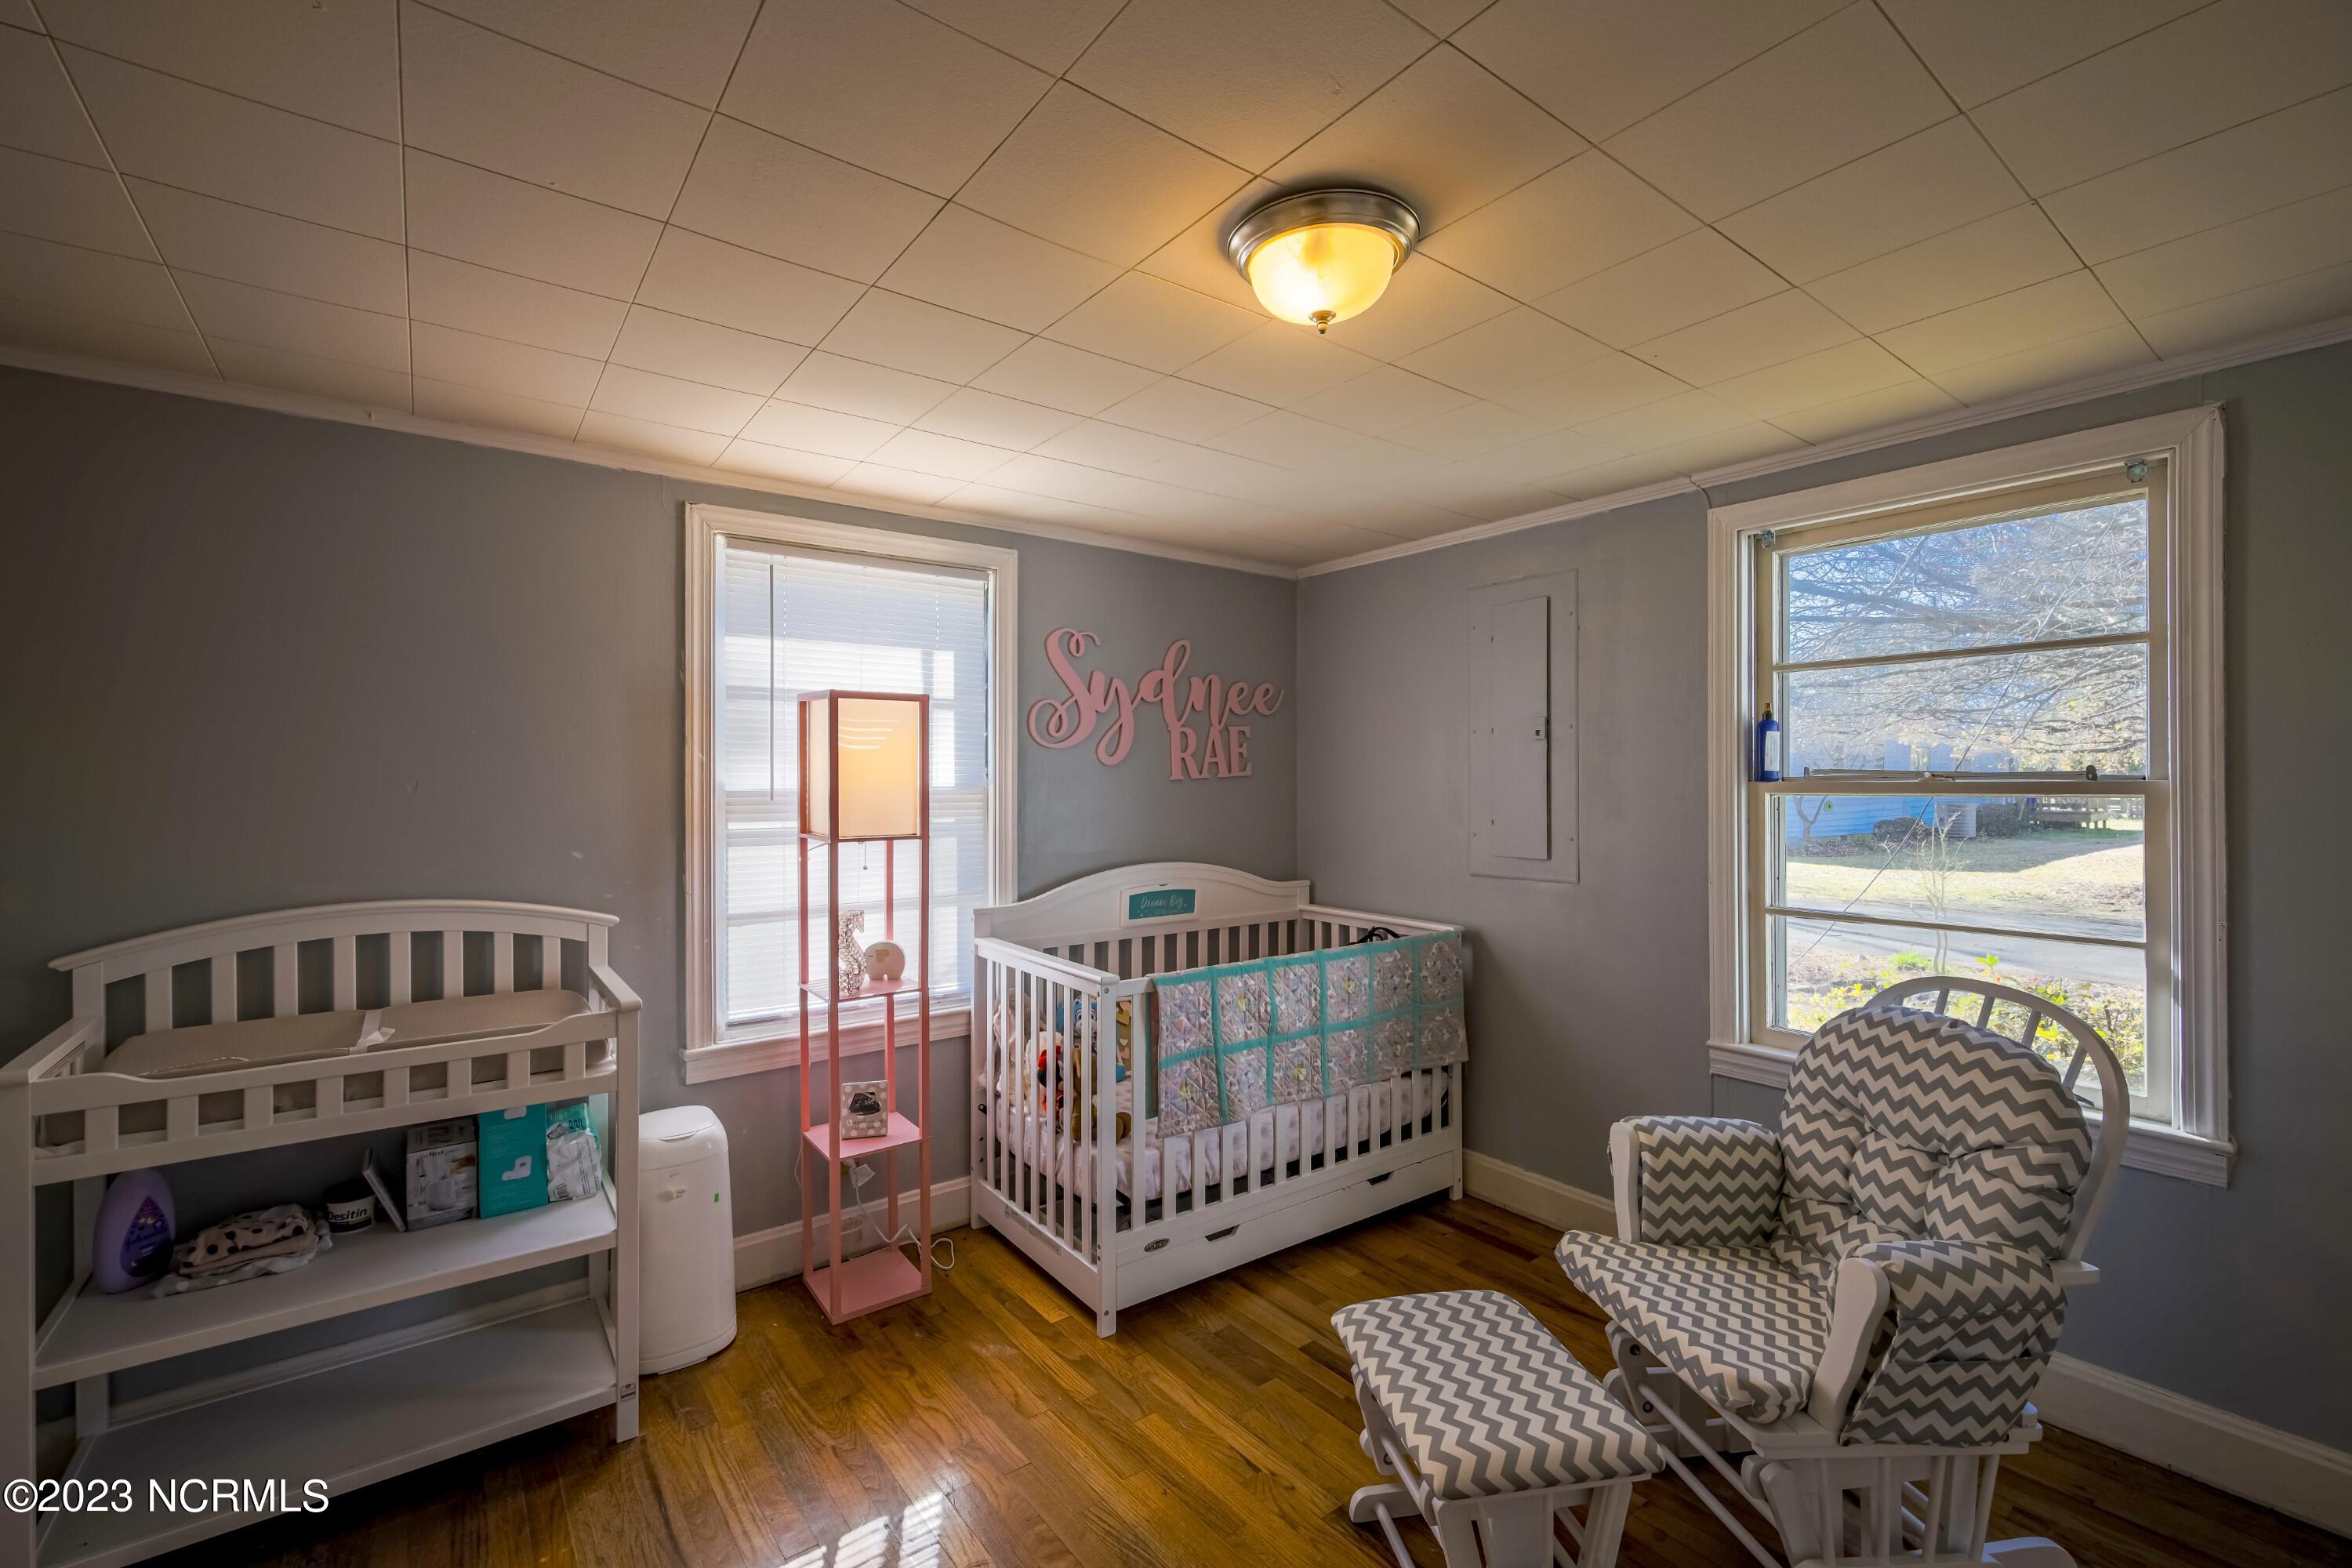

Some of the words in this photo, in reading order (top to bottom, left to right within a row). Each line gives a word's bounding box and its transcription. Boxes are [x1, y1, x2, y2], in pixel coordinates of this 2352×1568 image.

[1027, 627, 1285, 766] Sydnee
[1169, 726, 1252, 780] RAE
[1141, 896, 1167, 909] Dream
[326, 1208, 368, 1221] Desitin
